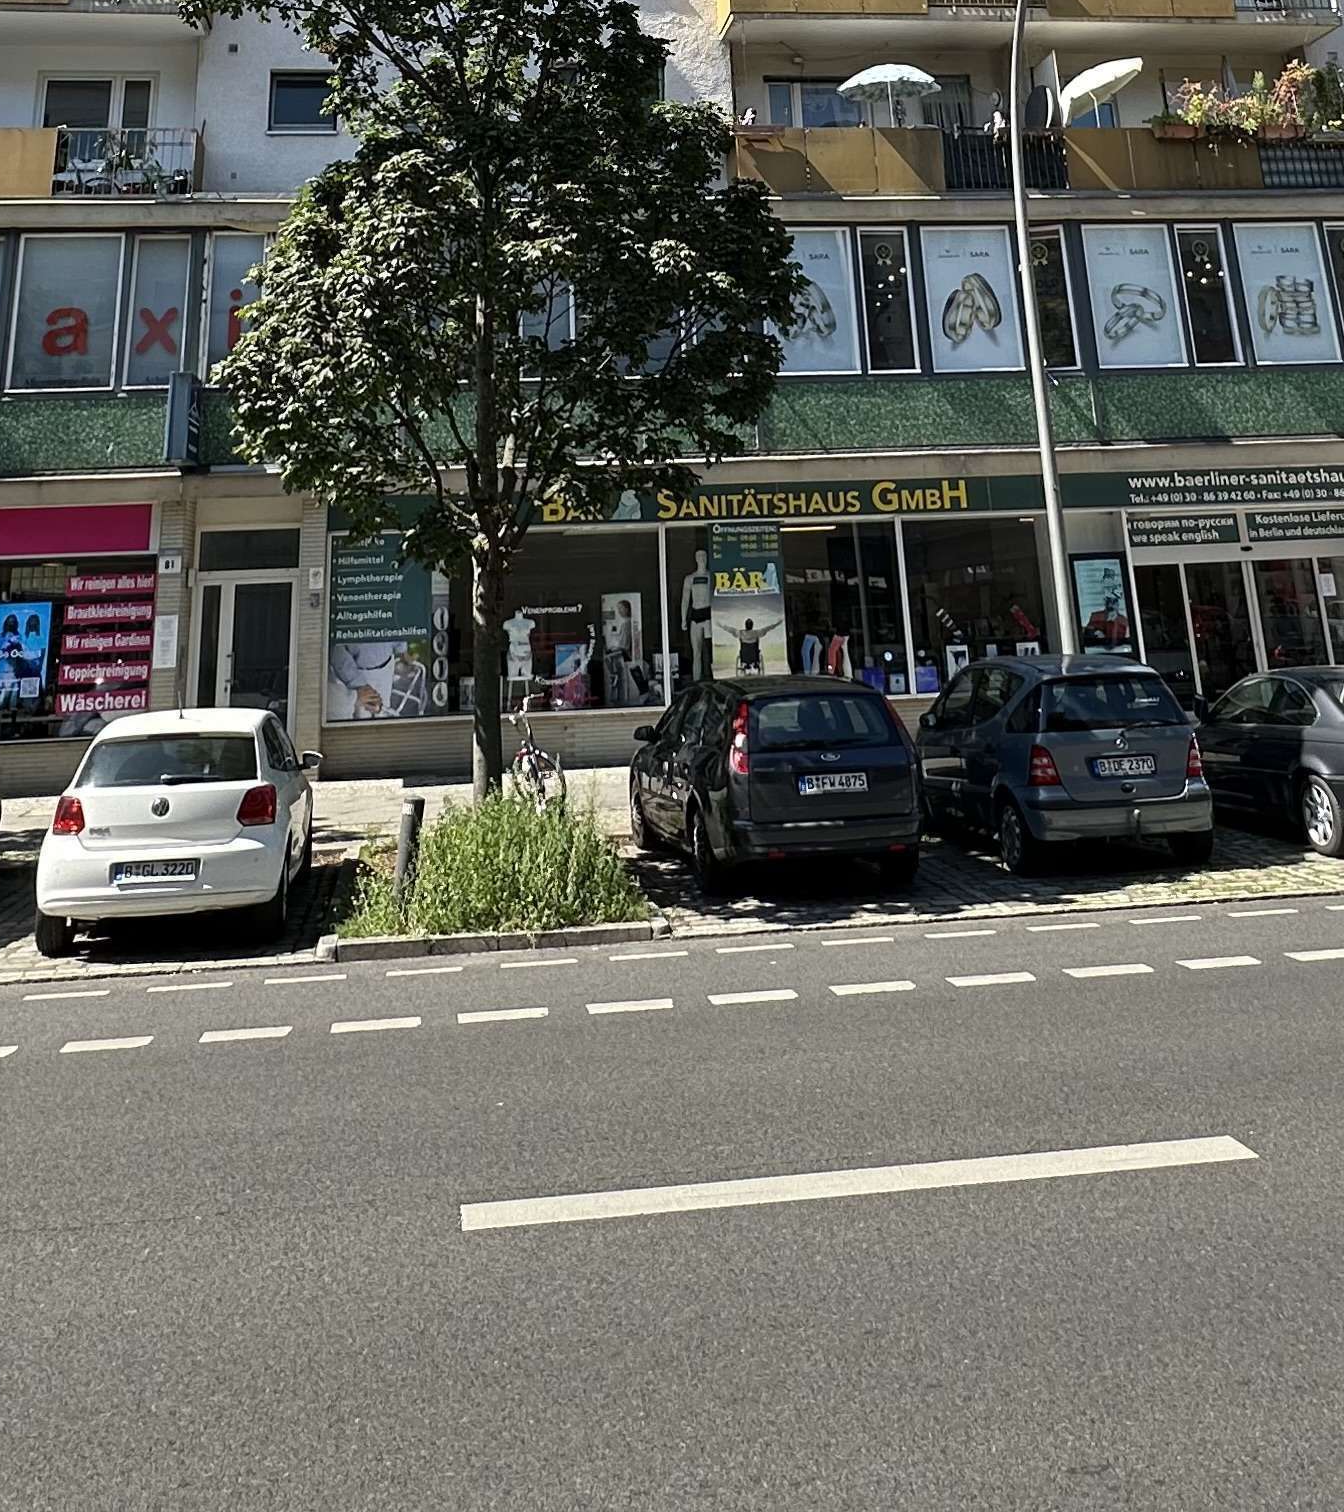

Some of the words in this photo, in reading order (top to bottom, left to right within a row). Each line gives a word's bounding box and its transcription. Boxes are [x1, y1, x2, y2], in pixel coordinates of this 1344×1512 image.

[656, 488, 861, 519] SANITÄTSHAUS
[1151, 493, 1169, 503] +49
[1185, 492, 1197, 502] 30
[1203, 492, 1215, 501] 86
[1217, 491, 1229, 501] 39
[1230, 491, 1242, 500] 42
[1243, 490, 1256, 500] 60
[1316, 489, 1327, 498] 30
[1255, 513, 1311, 524] Kostenlose
[1132, 534, 1148, 543] we
[1149, 531, 1180, 544] speak
[1181, 529, 1220, 543] english
[1259, 527, 1284, 538] Berlin
[337, 555, 384, 566] Hilfsmittel
[70, 578, 83, 591] Wir
[84, 577, 116, 593] reinigen
[117, 576, 136, 589] alles
[136, 575, 154, 588] hier!
[337, 573, 404, 585] Lymphtherapie
[714, 567, 767, 591] BÄR
[337, 592, 402, 602] Venentherapie
[67, 604, 152, 620] Brautkleidreinigung
[336, 609, 393, 622] Alltagshilfen
[336, 626, 428, 640] Rehabilitationshilfen
[65, 636, 80, 649] Wir
[81, 635, 113, 651] reinigen
[114, 633, 151, 647] Gardinen
[63, 663, 148, 680] Teppichreinigung
[60, 690, 147, 712] Wäscherei
[806, 777, 815, 790] B
[838, 774, 865, 788] 4875
[124, 865, 132, 878] B
[142, 864, 159, 877] GL
[161, 862, 194, 876] 3220
